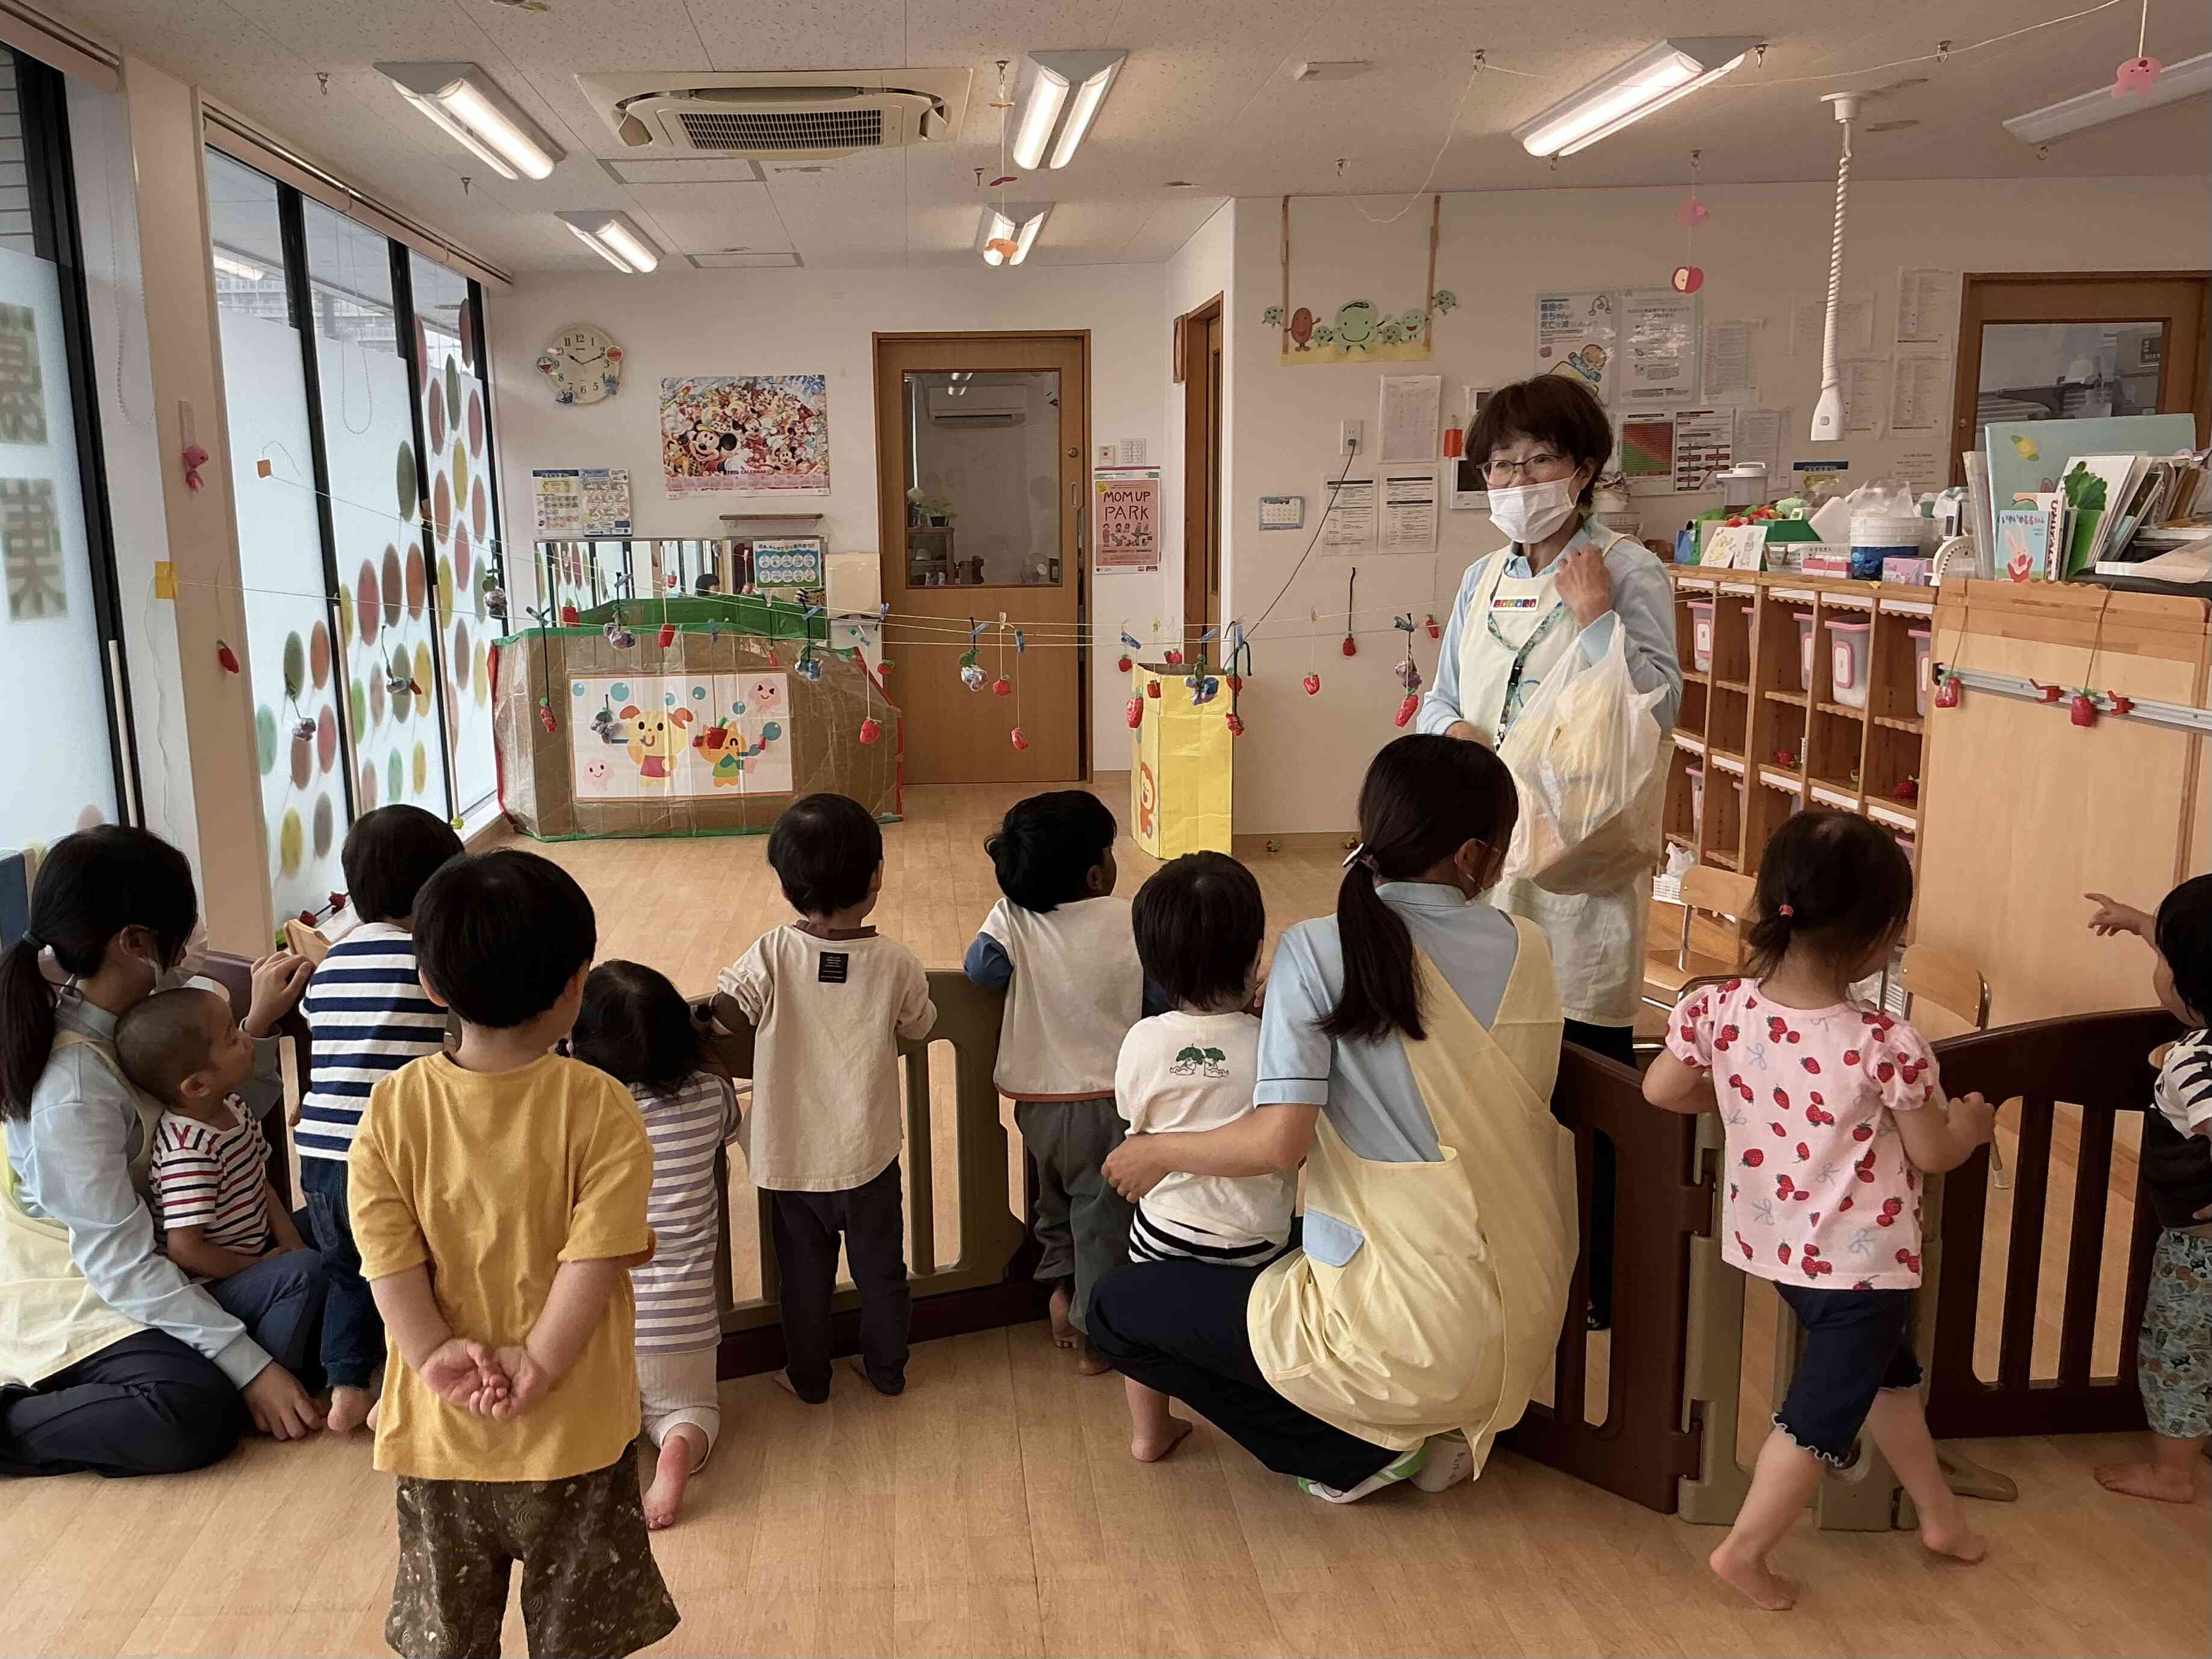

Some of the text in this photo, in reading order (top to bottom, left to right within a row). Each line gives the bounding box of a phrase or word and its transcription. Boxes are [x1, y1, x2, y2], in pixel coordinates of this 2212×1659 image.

[564, 337, 571, 346] 11
[576, 334, 585, 343] 12
[591, 337, 594, 346] 1
[599, 346, 606, 356] 2
[553, 360, 559, 369] 9
[603, 360, 609, 369] 3
[558, 373, 564, 382] 8
[600, 372, 606, 381] 4
[568, 382, 573, 391] 7
[581, 385, 587, 394] 6
[593, 382, 599, 391] 5
[1104, 505, 1150, 521] PARK
